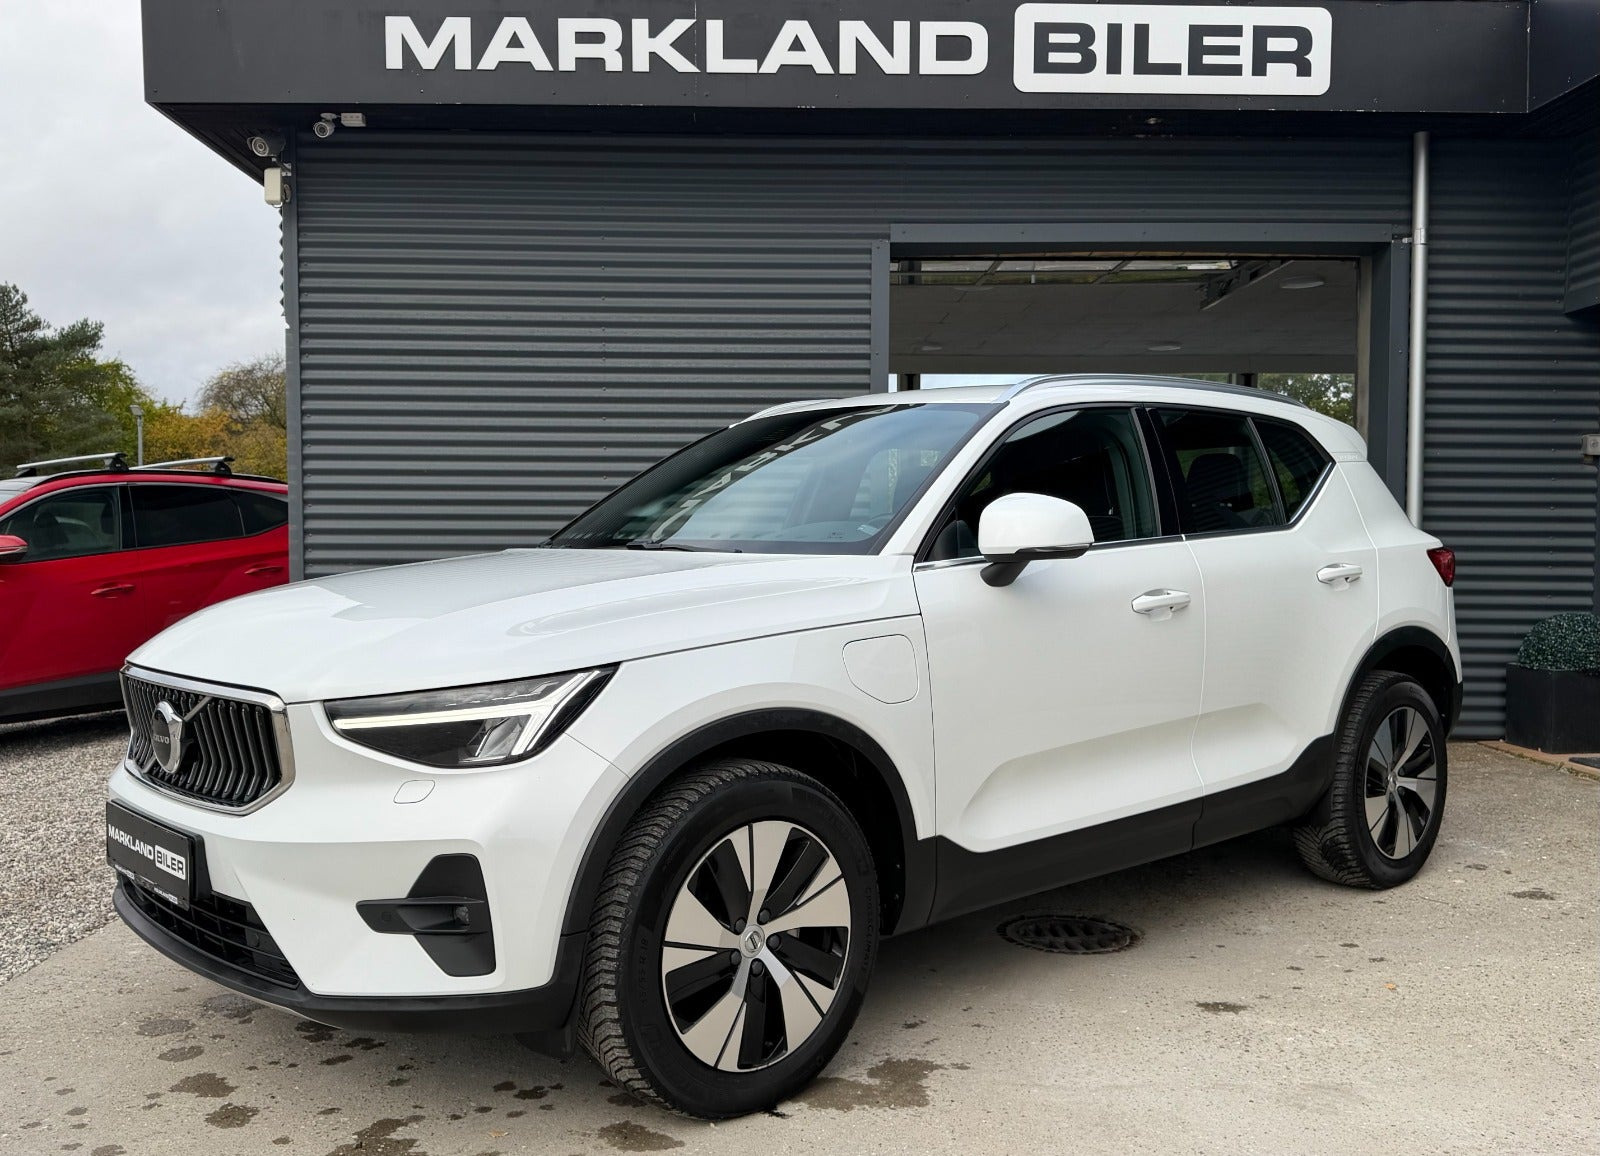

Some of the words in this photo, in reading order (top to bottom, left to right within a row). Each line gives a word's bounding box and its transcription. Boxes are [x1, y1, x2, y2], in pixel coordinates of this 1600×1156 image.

[384, 15, 989, 76] MARKLAND
[1033, 21, 1314, 78] BILER
[153, 733, 170, 745] OLVO
[108, 823, 154, 861] MARKLAND
[156, 849, 185, 876] BILER
